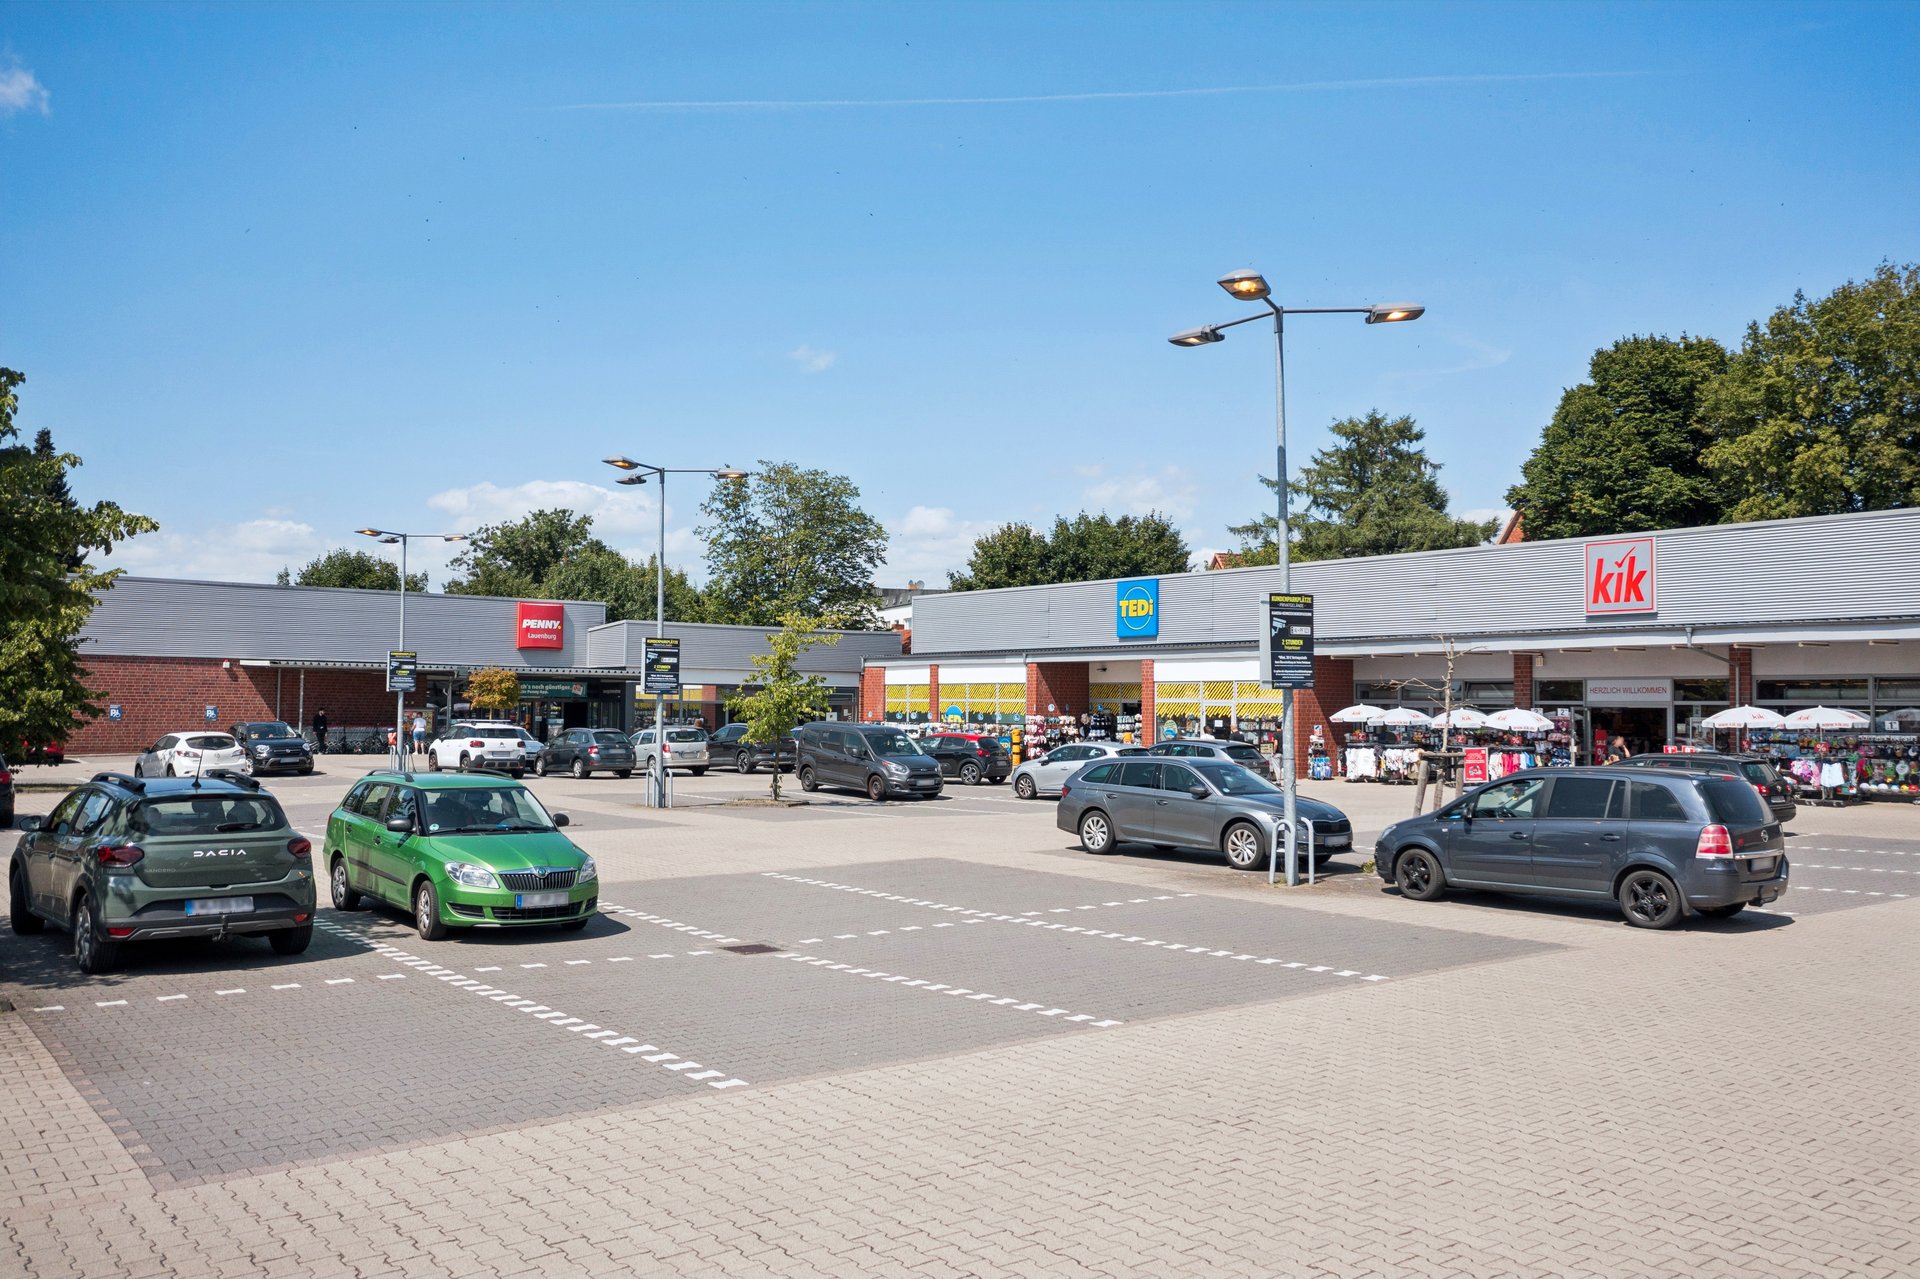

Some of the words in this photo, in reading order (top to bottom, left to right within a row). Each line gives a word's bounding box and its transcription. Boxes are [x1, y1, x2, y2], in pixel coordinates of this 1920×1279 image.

[1592, 549, 1648, 604] kik
[1119, 598, 1154, 618] TEDi
[527, 632, 557, 640] Lauenburg
[545, 683, 571, 691] günstiger.
[1622, 686, 1667, 694] WILLKOMMEN
[193, 849, 247, 858] DACIA
